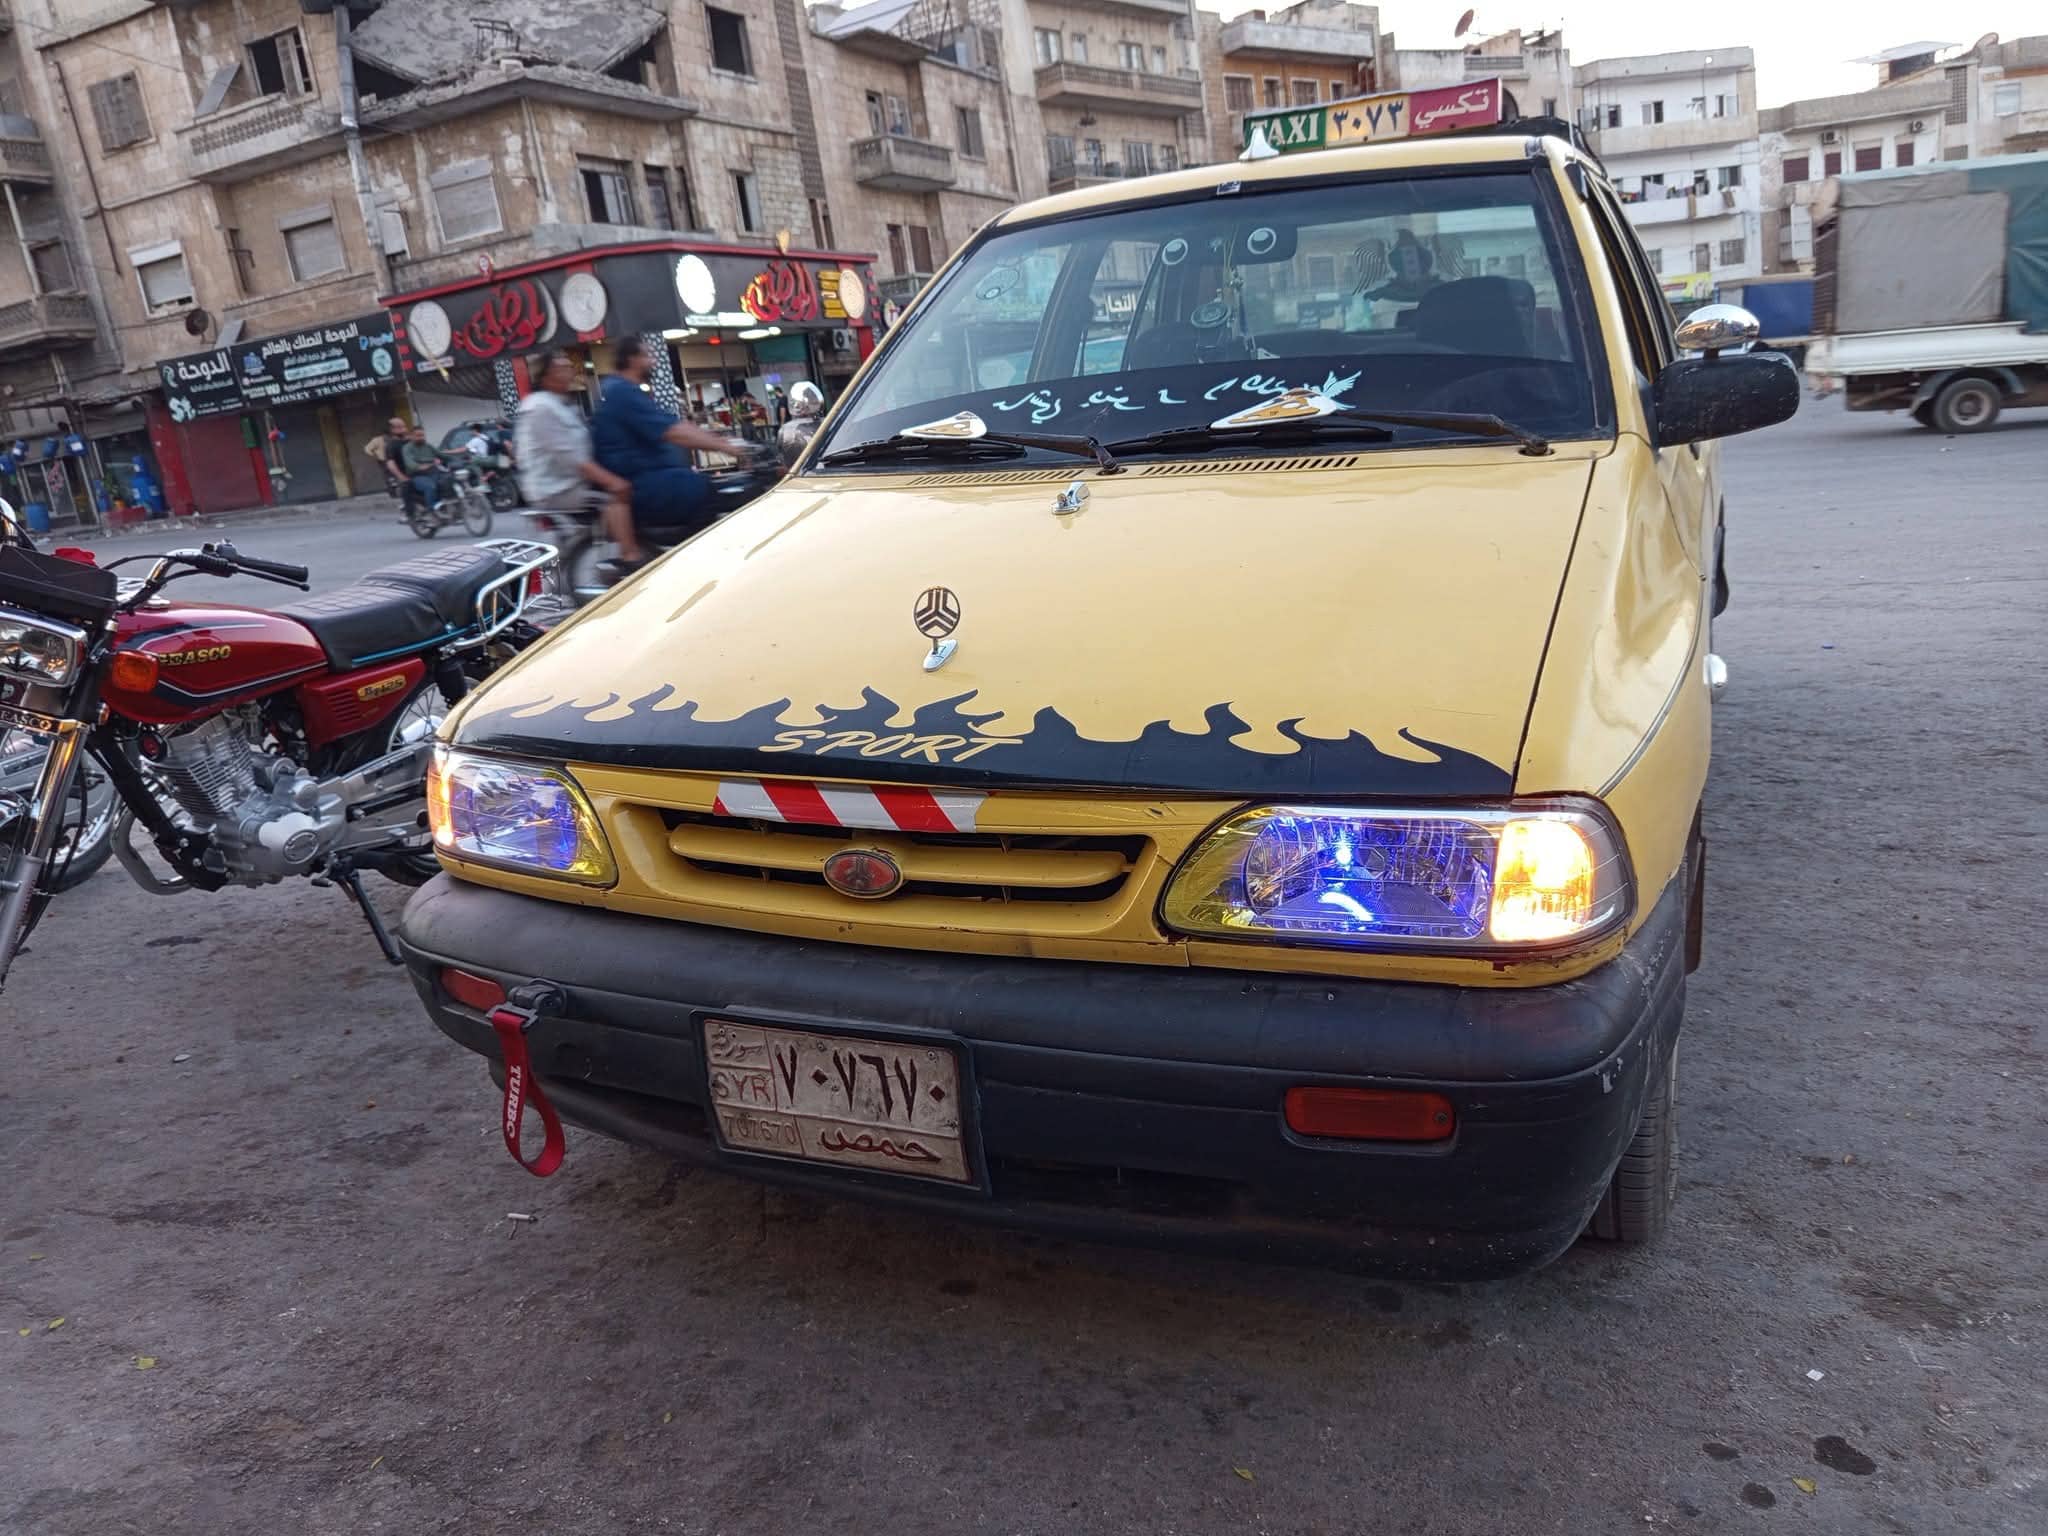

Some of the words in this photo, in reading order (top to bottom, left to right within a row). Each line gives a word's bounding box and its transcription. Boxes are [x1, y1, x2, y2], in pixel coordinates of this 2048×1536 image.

[1414, 87, 1490, 129] تكسي
[325, 322, 359, 344] الدوحة
[177, 351, 231, 381] الدوحة
[271, 390, 311, 405] MONEY
[315, 377, 377, 398] TRANSFER
[758, 729, 1024, 763] SPORT
[712, 1069, 772, 1103] SYR
[774, 1042, 947, 1124] ٧٠٧٦٧٠
[817, 1127, 943, 1164] حمص
